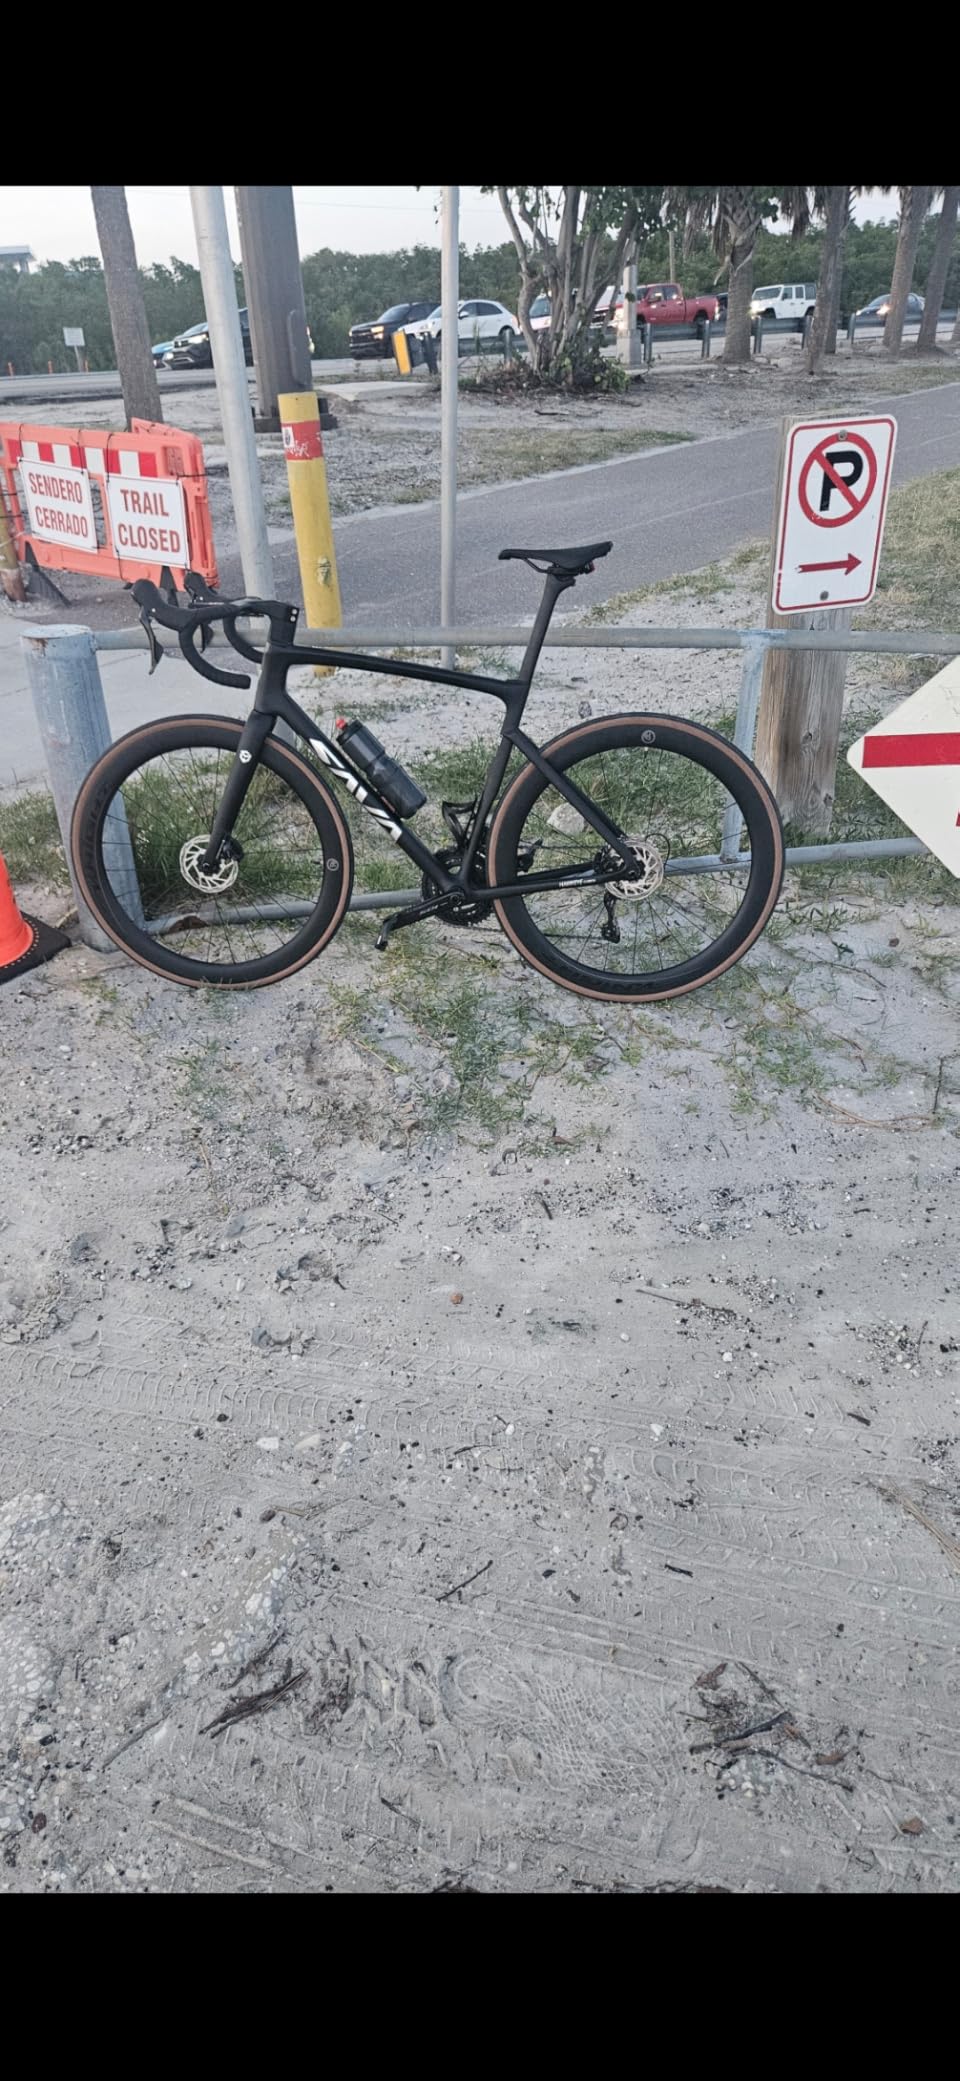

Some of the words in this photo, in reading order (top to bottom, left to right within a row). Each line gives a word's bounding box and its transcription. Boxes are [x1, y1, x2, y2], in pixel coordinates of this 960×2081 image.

[28, 472, 83, 504] SENDERO
[819, 450, 864, 512] P
[120, 489, 170, 517] TRAIL
[35, 506, 88, 538] CERRADO
[118, 523, 181, 553] CLOSED
